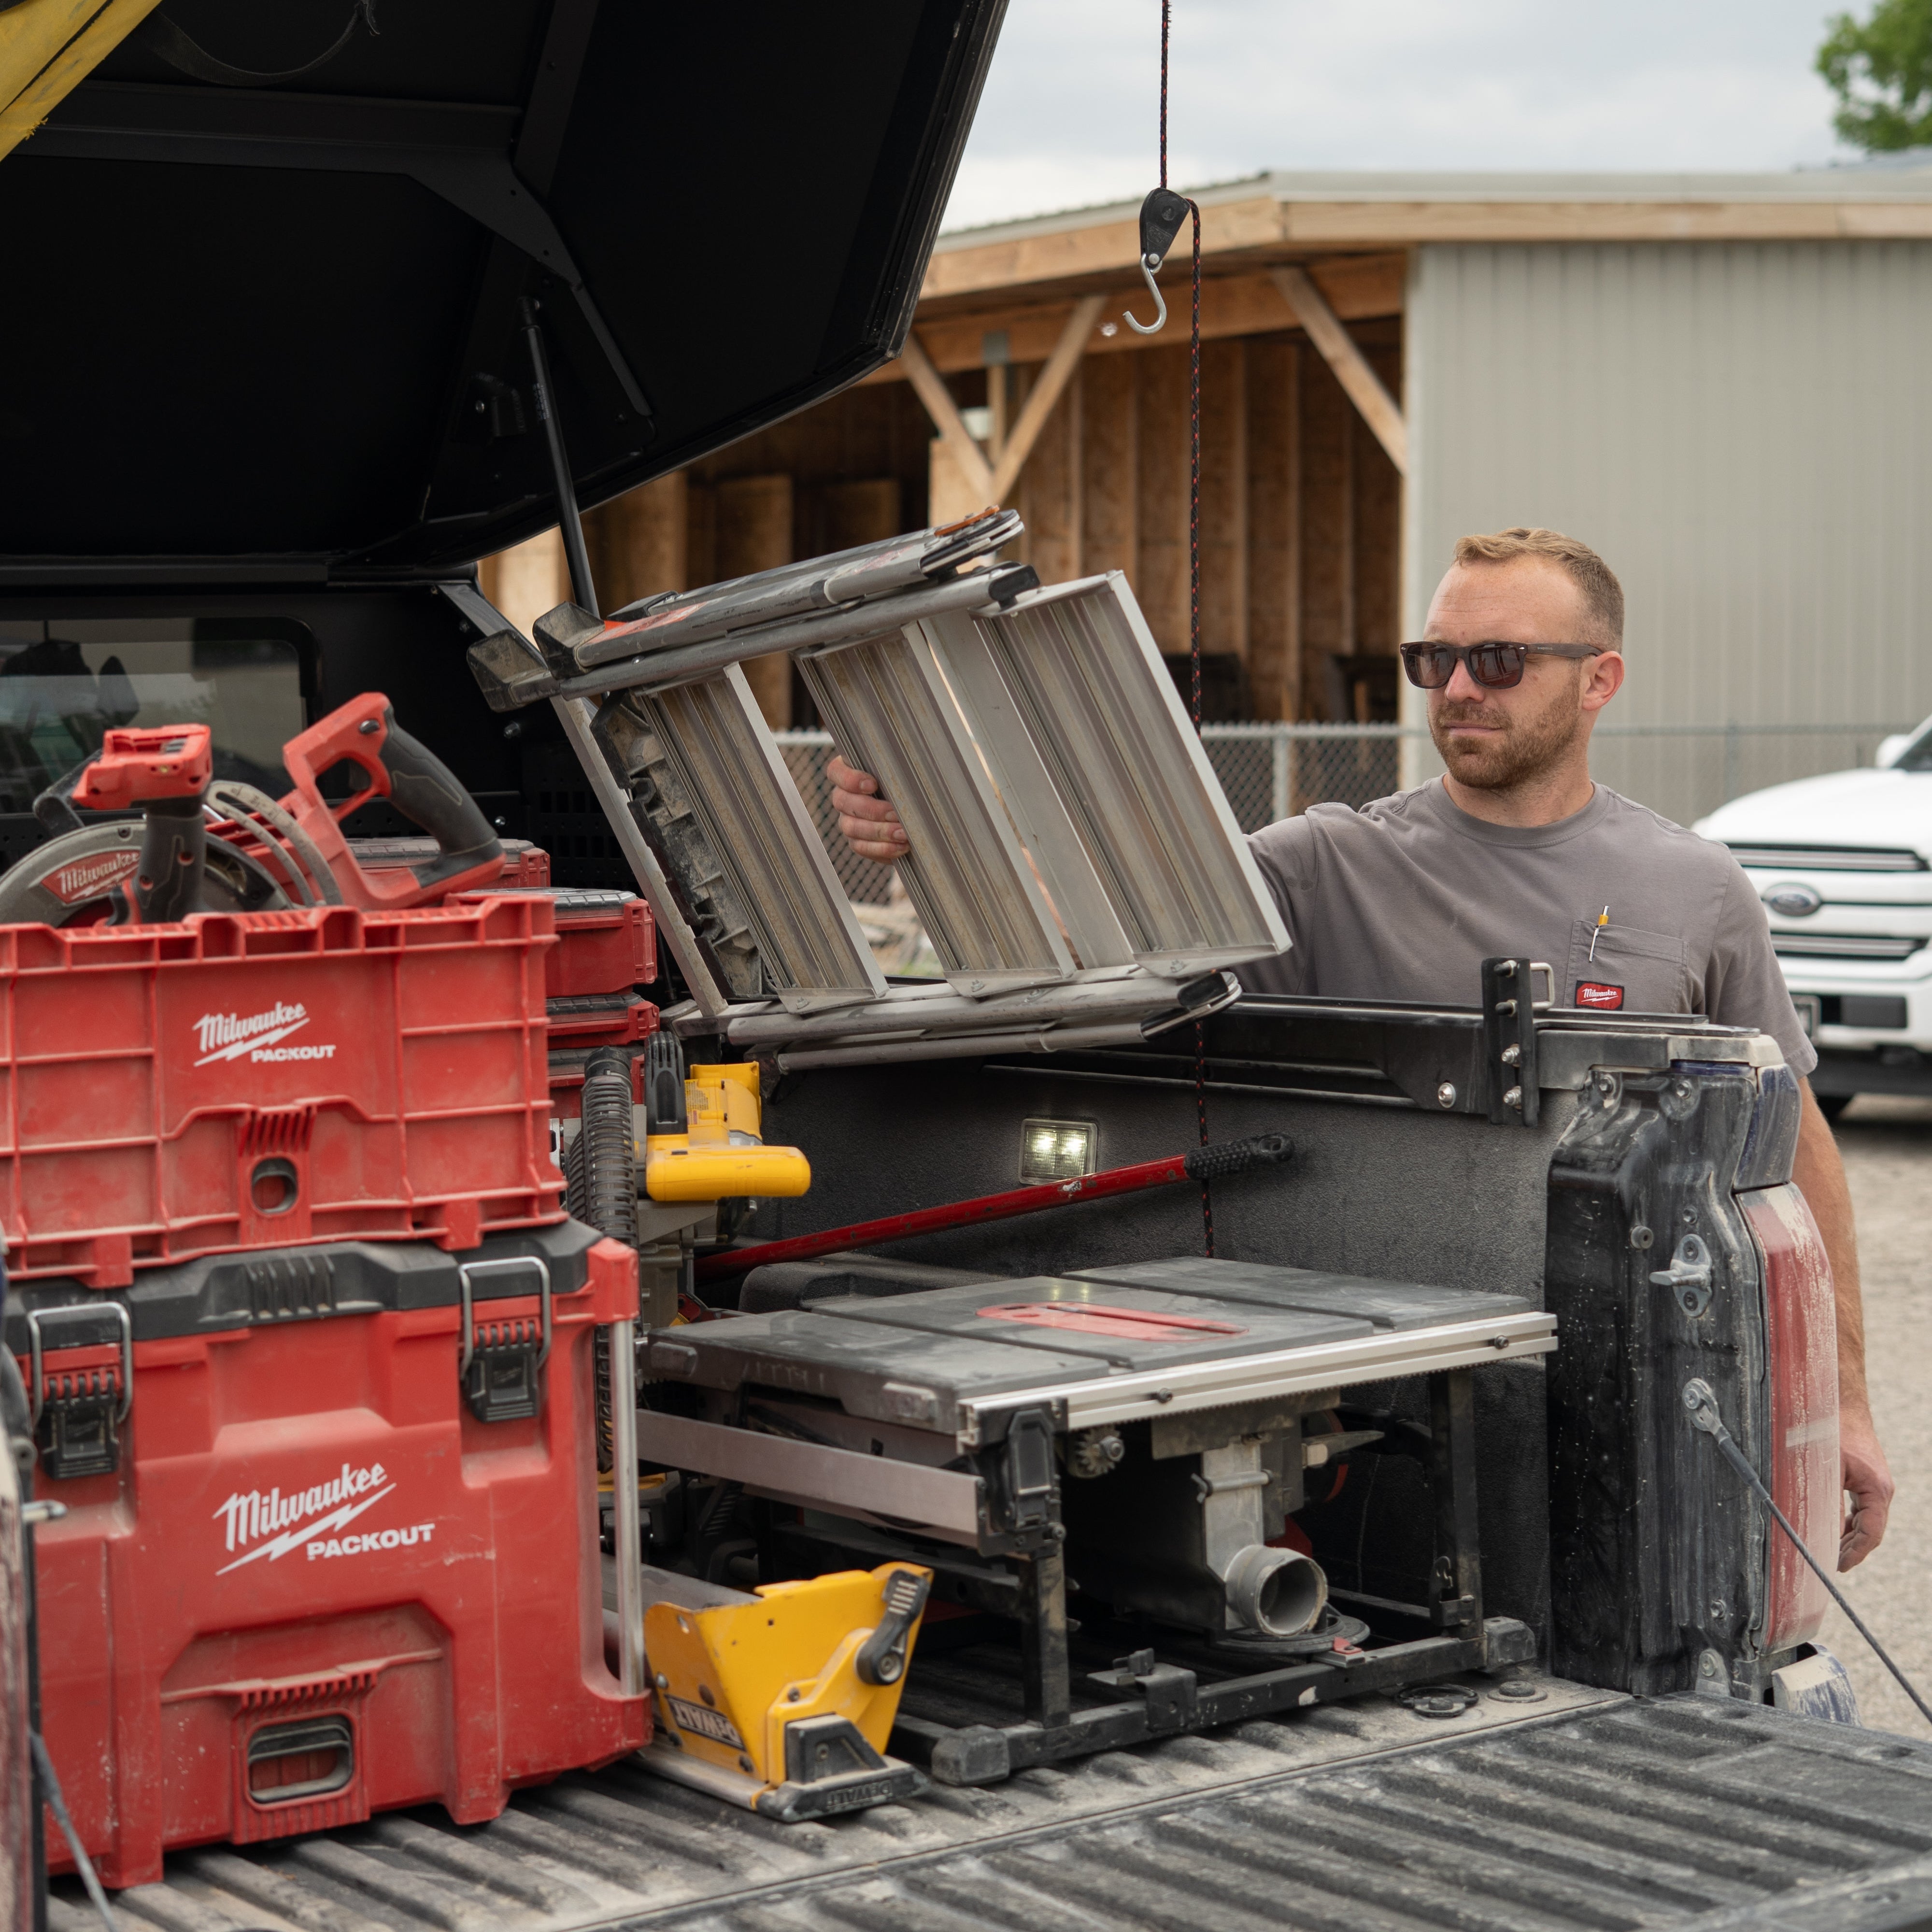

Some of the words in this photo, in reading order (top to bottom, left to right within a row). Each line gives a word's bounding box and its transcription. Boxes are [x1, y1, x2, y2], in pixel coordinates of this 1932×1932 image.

[57, 852, 139, 894] Milwaukee
[1581, 988, 1618, 998] Milwaukee
[192, 1001, 306, 1053] Milwaukee
[252, 1045, 336, 1063] PACKOUT
[212, 1463, 387, 1552] Milwaukee
[306, 1523, 435, 1561] PACKOUT
[672, 1703, 742, 1745] DEWALT
[826, 1780, 893, 1808] DEWALT
